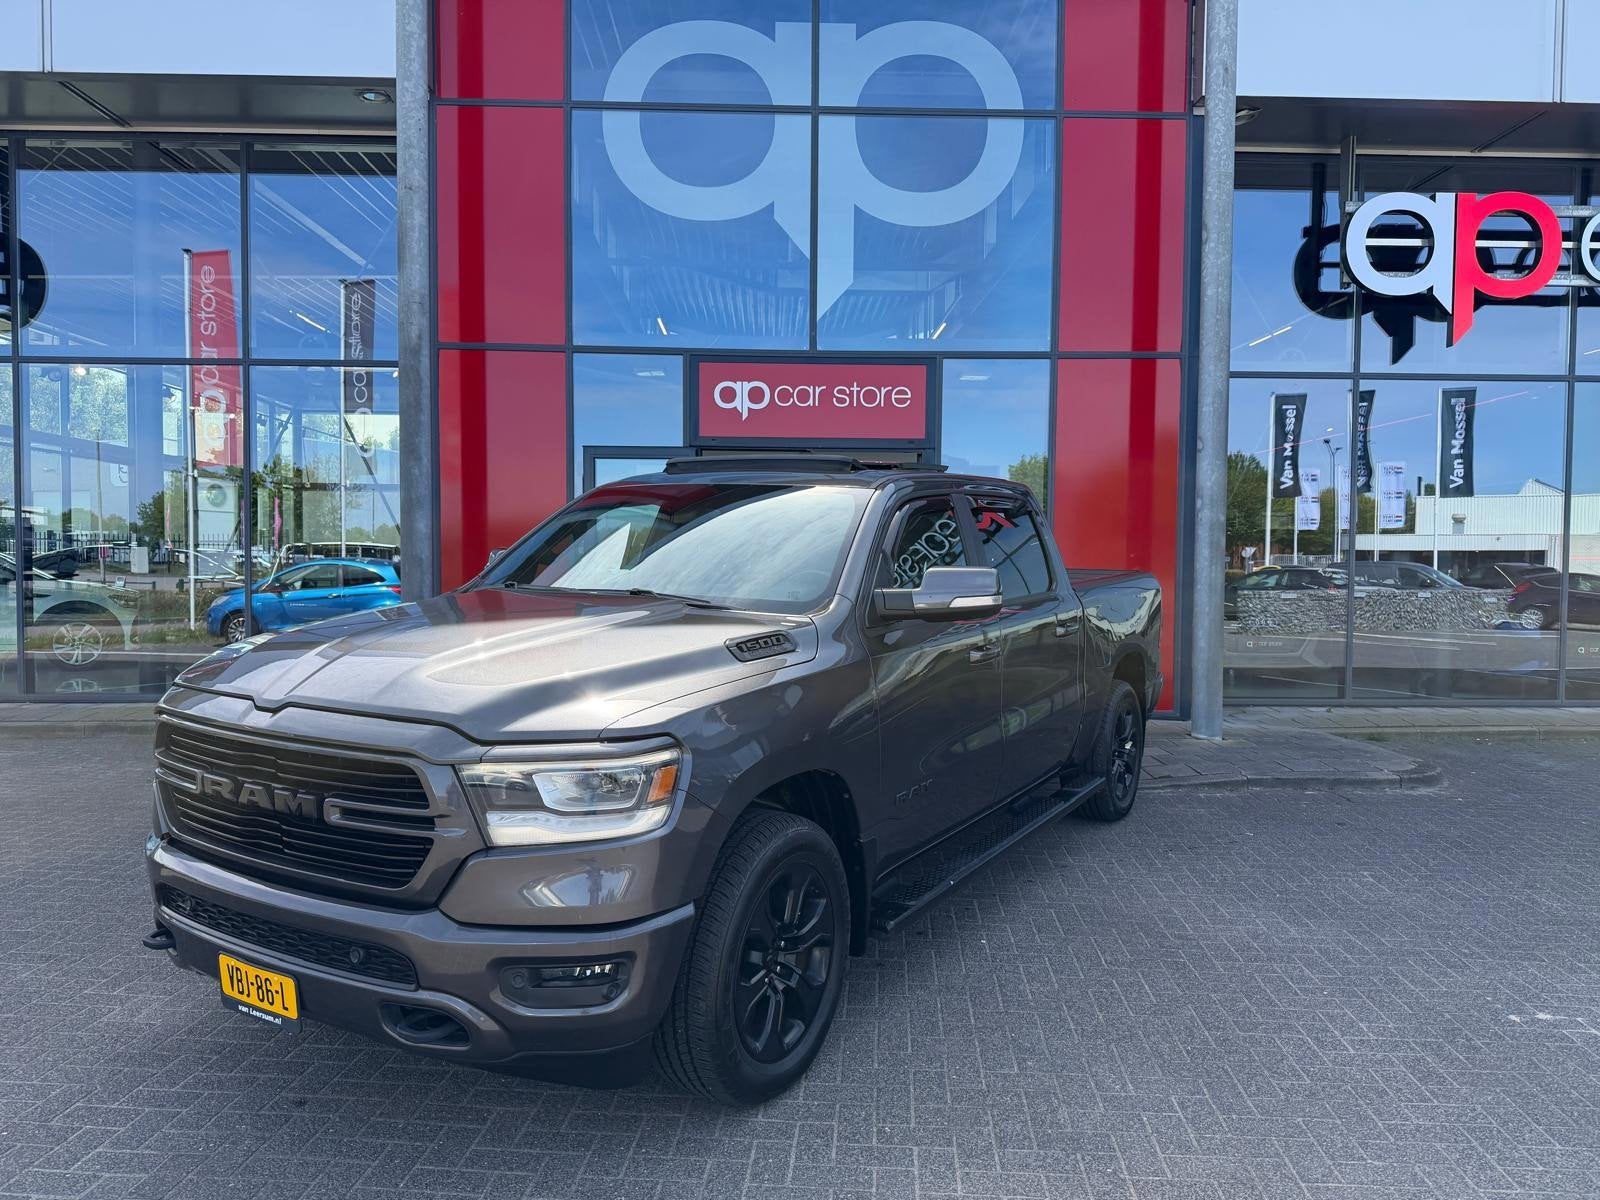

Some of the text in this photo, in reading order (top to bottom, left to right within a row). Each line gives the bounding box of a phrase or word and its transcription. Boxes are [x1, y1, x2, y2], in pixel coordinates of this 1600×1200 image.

[1346, 191, 1562, 346] ap
[200, 265, 216, 336] store
[713, 380, 911, 422] ap car store
[1279, 404, 1297, 490] Van Mossel
[1449, 398, 1466, 489] Van Mossel
[736, 635, 786, 653] 1500
[204, 772, 317, 824] RAM
[227, 963, 289, 1012] VBJ-86-L
[238, 1005, 282, 1025] van Leersum.nl
